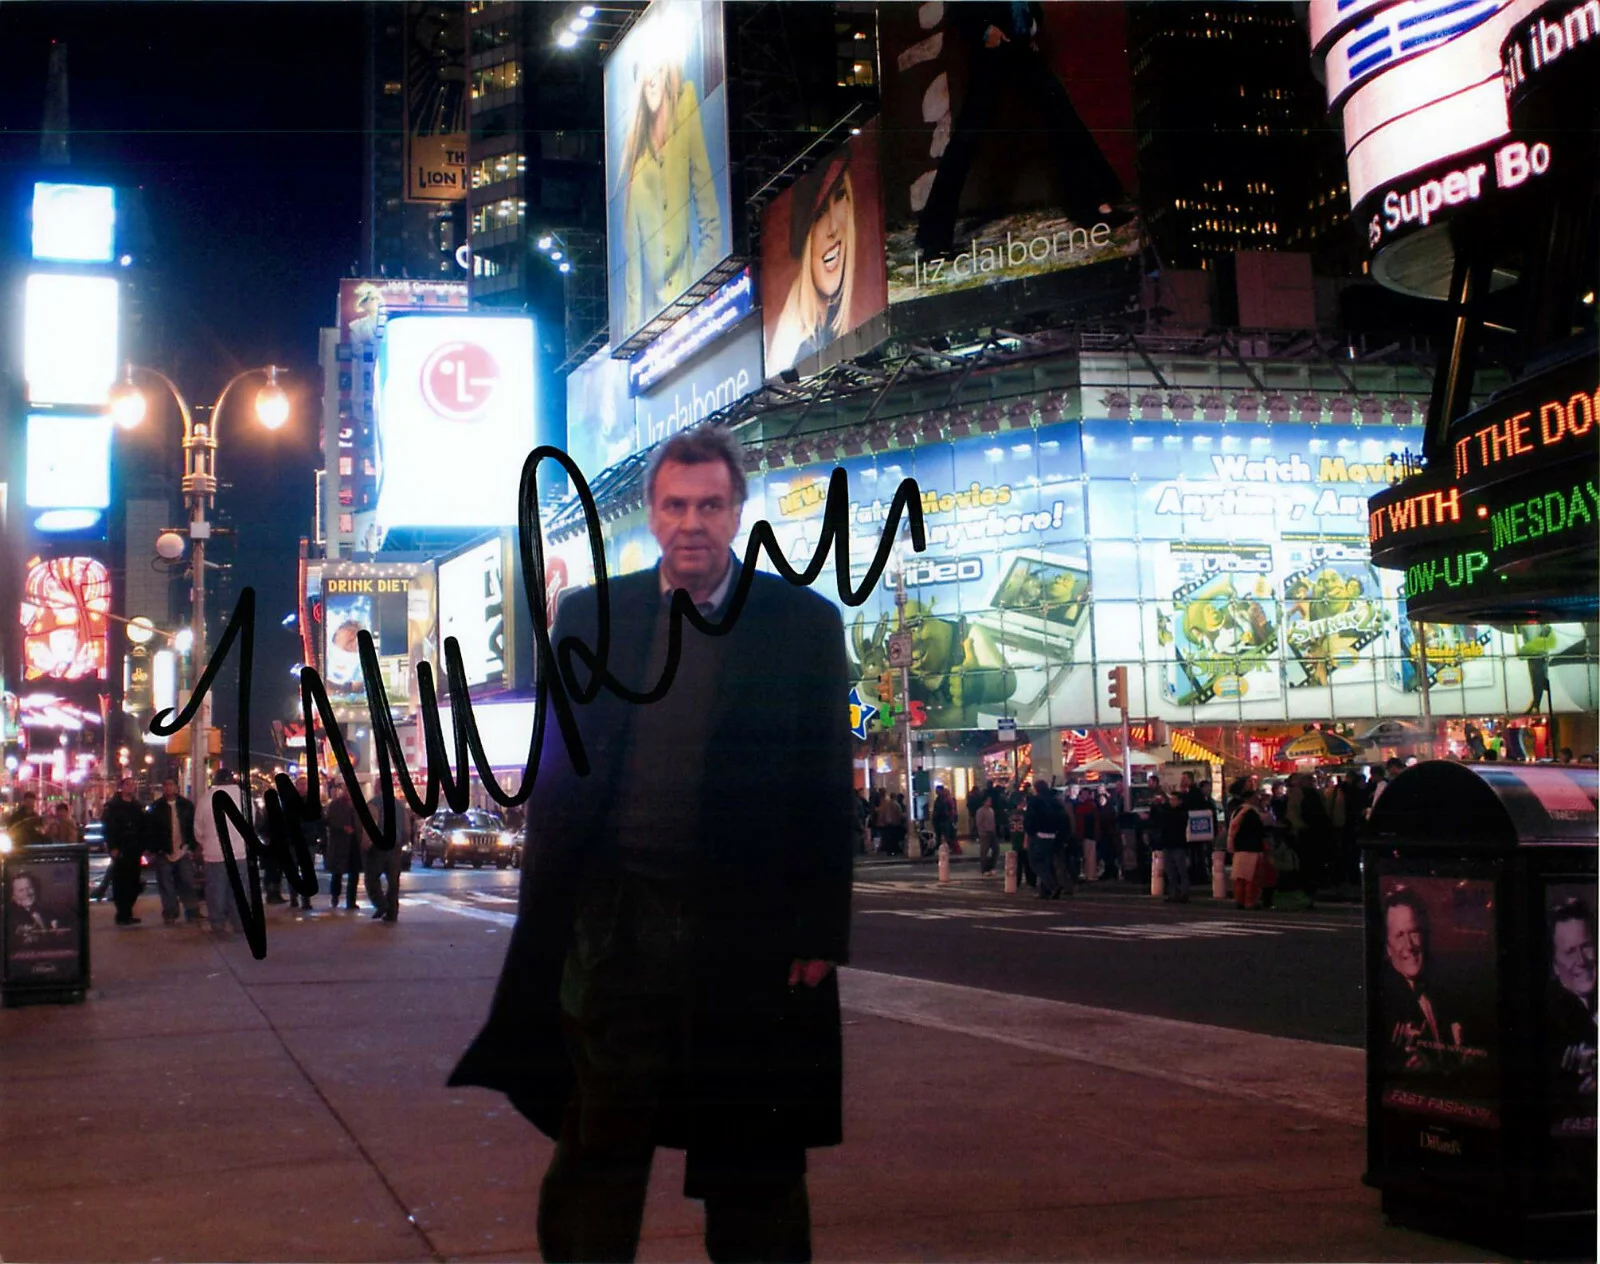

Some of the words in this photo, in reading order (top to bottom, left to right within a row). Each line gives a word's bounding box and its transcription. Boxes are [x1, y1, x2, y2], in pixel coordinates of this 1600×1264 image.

[418, 166, 457, 188] LION
[446, 150, 466, 164] TH
[1384, 163, 1487, 231] Super
[1494, 142, 1551, 189] Bo
[914, 251, 946, 290] liz
[953, 222, 1111, 277] claiborne
[667, 368, 749, 434] claiborne
[1475, 411, 1534, 467] THE
[1210, 453, 1312, 482] Watch
[1388, 488, 1460, 533] WITH
[328, 580, 373, 592] DRINK
[378, 580, 409, 592] DIET
